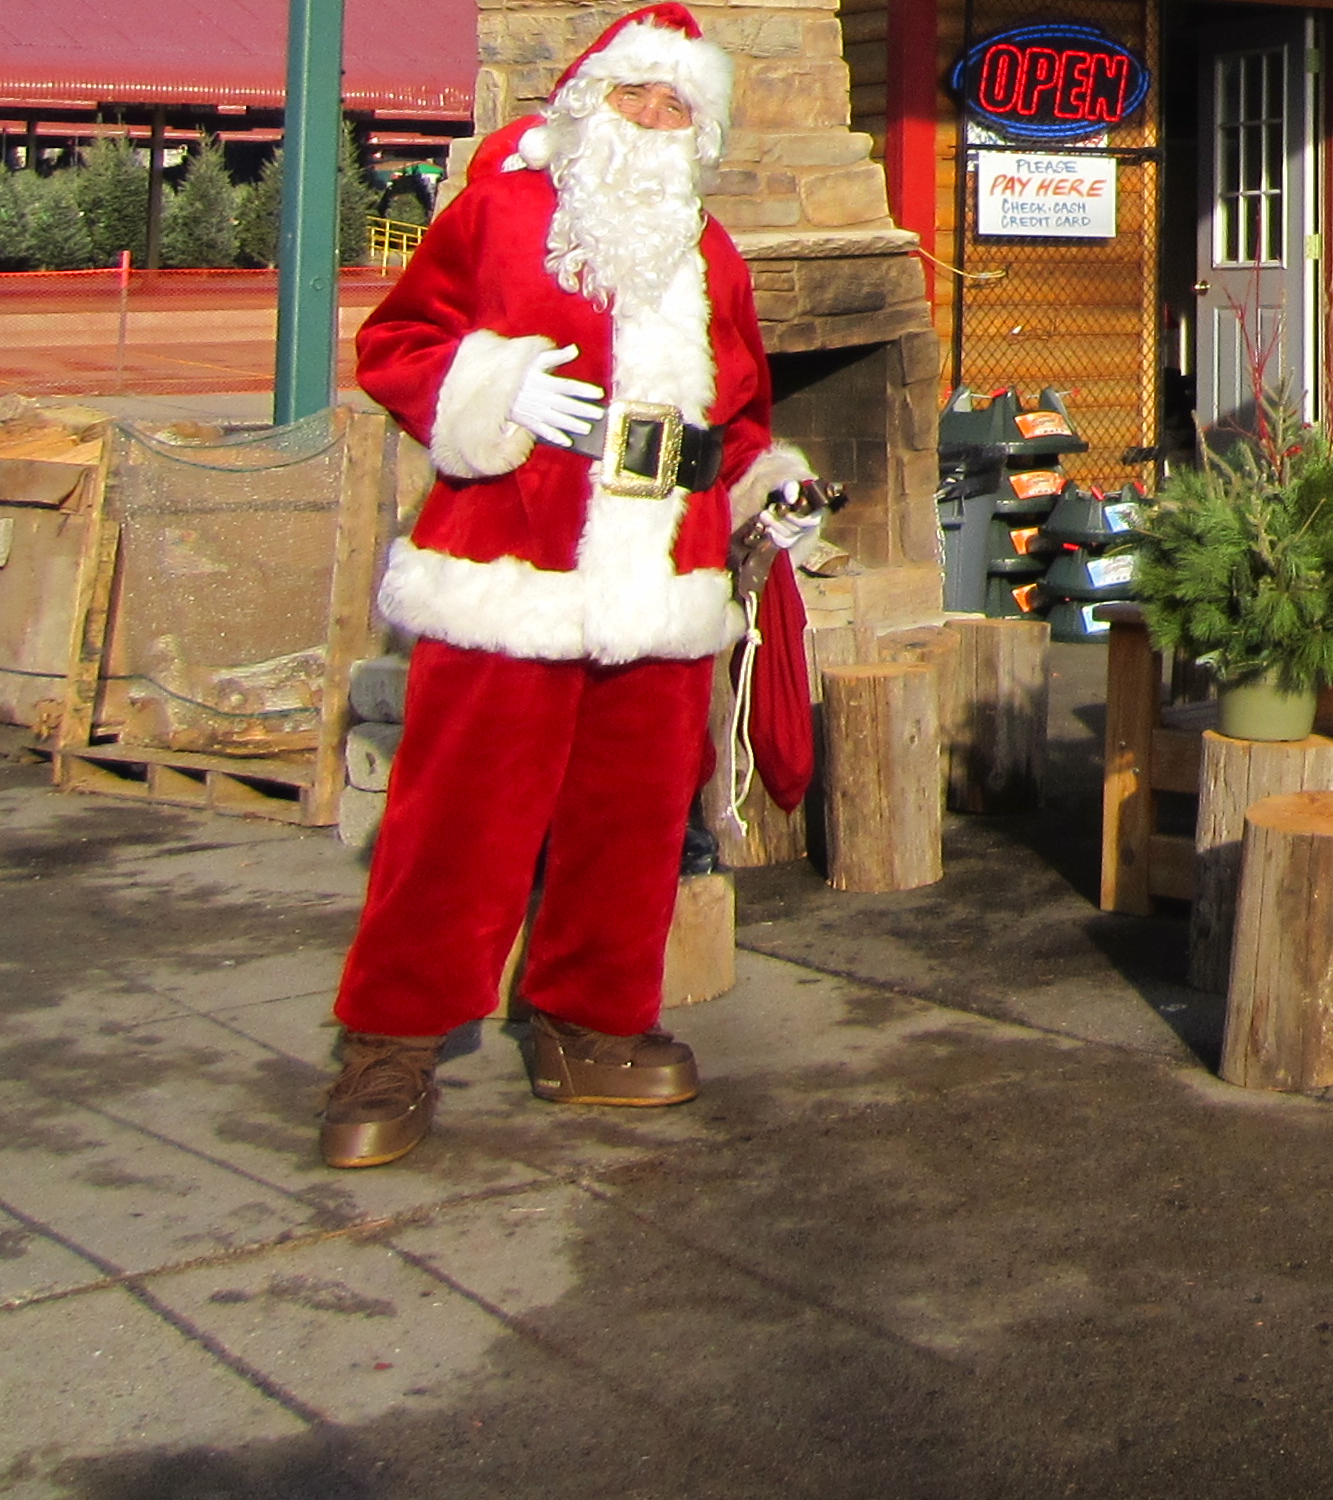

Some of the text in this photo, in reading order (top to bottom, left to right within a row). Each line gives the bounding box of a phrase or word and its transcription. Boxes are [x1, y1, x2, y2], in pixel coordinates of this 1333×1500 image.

[979, 44, 1129, 122] OPEN
[1015, 159, 1077, 174] PLEASE
[989, 174, 1107, 197] PAY HERE
[1001, 215, 1091, 229] CREDIT CARD
